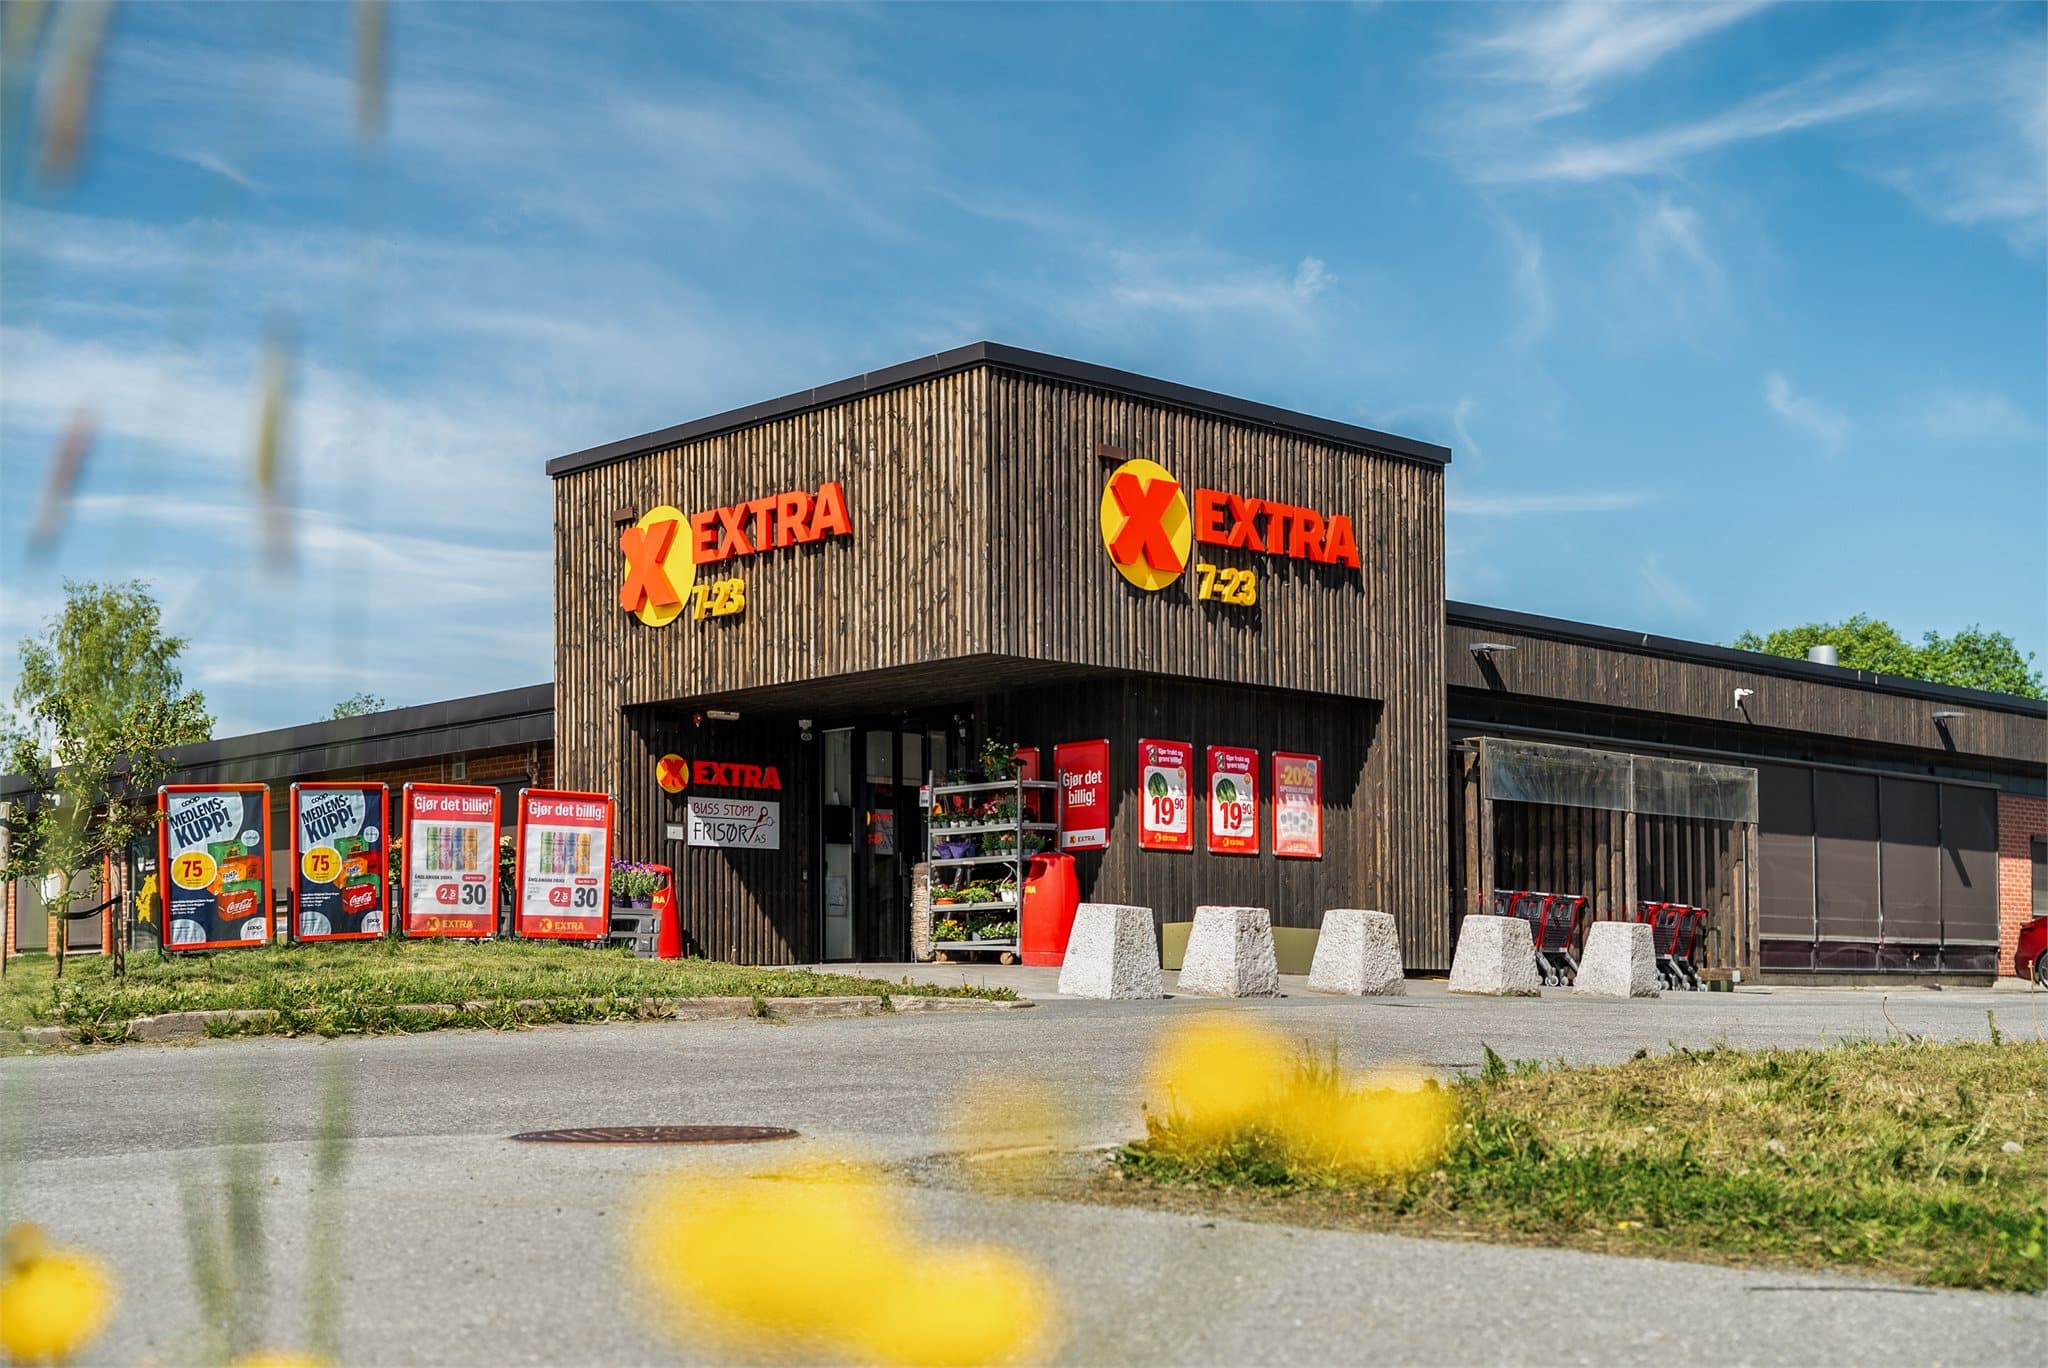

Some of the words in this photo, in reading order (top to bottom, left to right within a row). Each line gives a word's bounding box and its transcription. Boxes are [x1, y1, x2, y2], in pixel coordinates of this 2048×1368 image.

[691, 482, 852, 564] EXTRA
[1195, 488, 1361, 569] EXTRA
[1196, 563, 1258, 607] 7-23
[692, 577, 747, 621] 7-23
[693, 760, 782, 790] EXTRA
[1063, 772, 1084, 790] Gjør
[1085, 769, 1102, 785] det
[1280, 766, 1313, 787] -20%
[414, 797, 438, 813] Gjør
[440, 797, 460, 811] det
[462, 798, 493, 815] billig!
[1068, 788, 1096, 807] billig!
[169, 797, 224, 829] MEDLEMS-
[301, 794, 348, 825] MEDLEMS-
[529, 801, 553, 818] Gjør
[555, 804, 574, 817] det
[576, 804, 605, 821] billig!
[693, 802, 720, 815] BUSS
[724, 804, 754, 817] STOPP
[1152, 796, 1175, 826] 19
[1175, 798, 1184, 810] 90
[1220, 802, 1242, 830] 19
[1242, 804, 1252, 815] 90
[174, 807, 233, 849] KUPP!
[305, 804, 357, 844] KUPP!
[693, 822, 748, 843] FRISØR
[754, 833, 767, 844] AS
[182, 860, 203, 879] 75
[312, 854, 330, 872] 75
[440, 887, 448, 900] 2
[462, 883, 487, 905] 30
[553, 890, 560, 903] 2
[574, 887, 598, 908] 30
[442, 920, 474, 929] EXTRA
[554, 921, 584, 931] EXTRA
